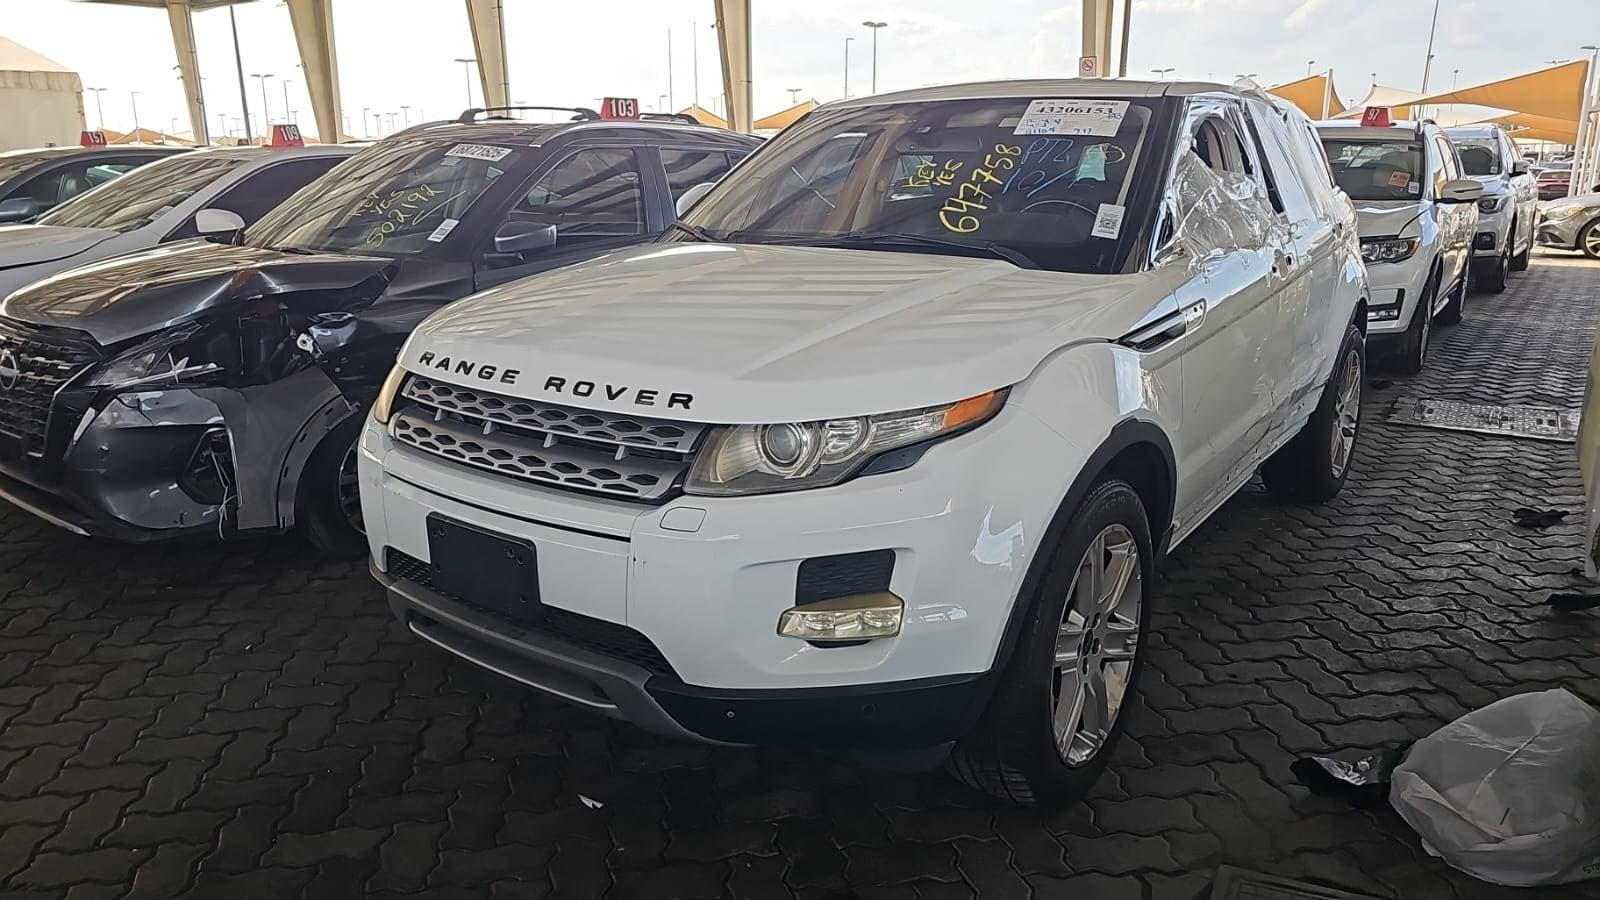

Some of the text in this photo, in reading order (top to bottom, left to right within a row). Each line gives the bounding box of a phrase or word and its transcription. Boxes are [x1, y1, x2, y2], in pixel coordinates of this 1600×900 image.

[611, 99, 635, 117] 103
[280, 126, 299, 142] 109
[938, 143, 1022, 233] 647758
[419, 351, 694, 410] RANGE ROVER
